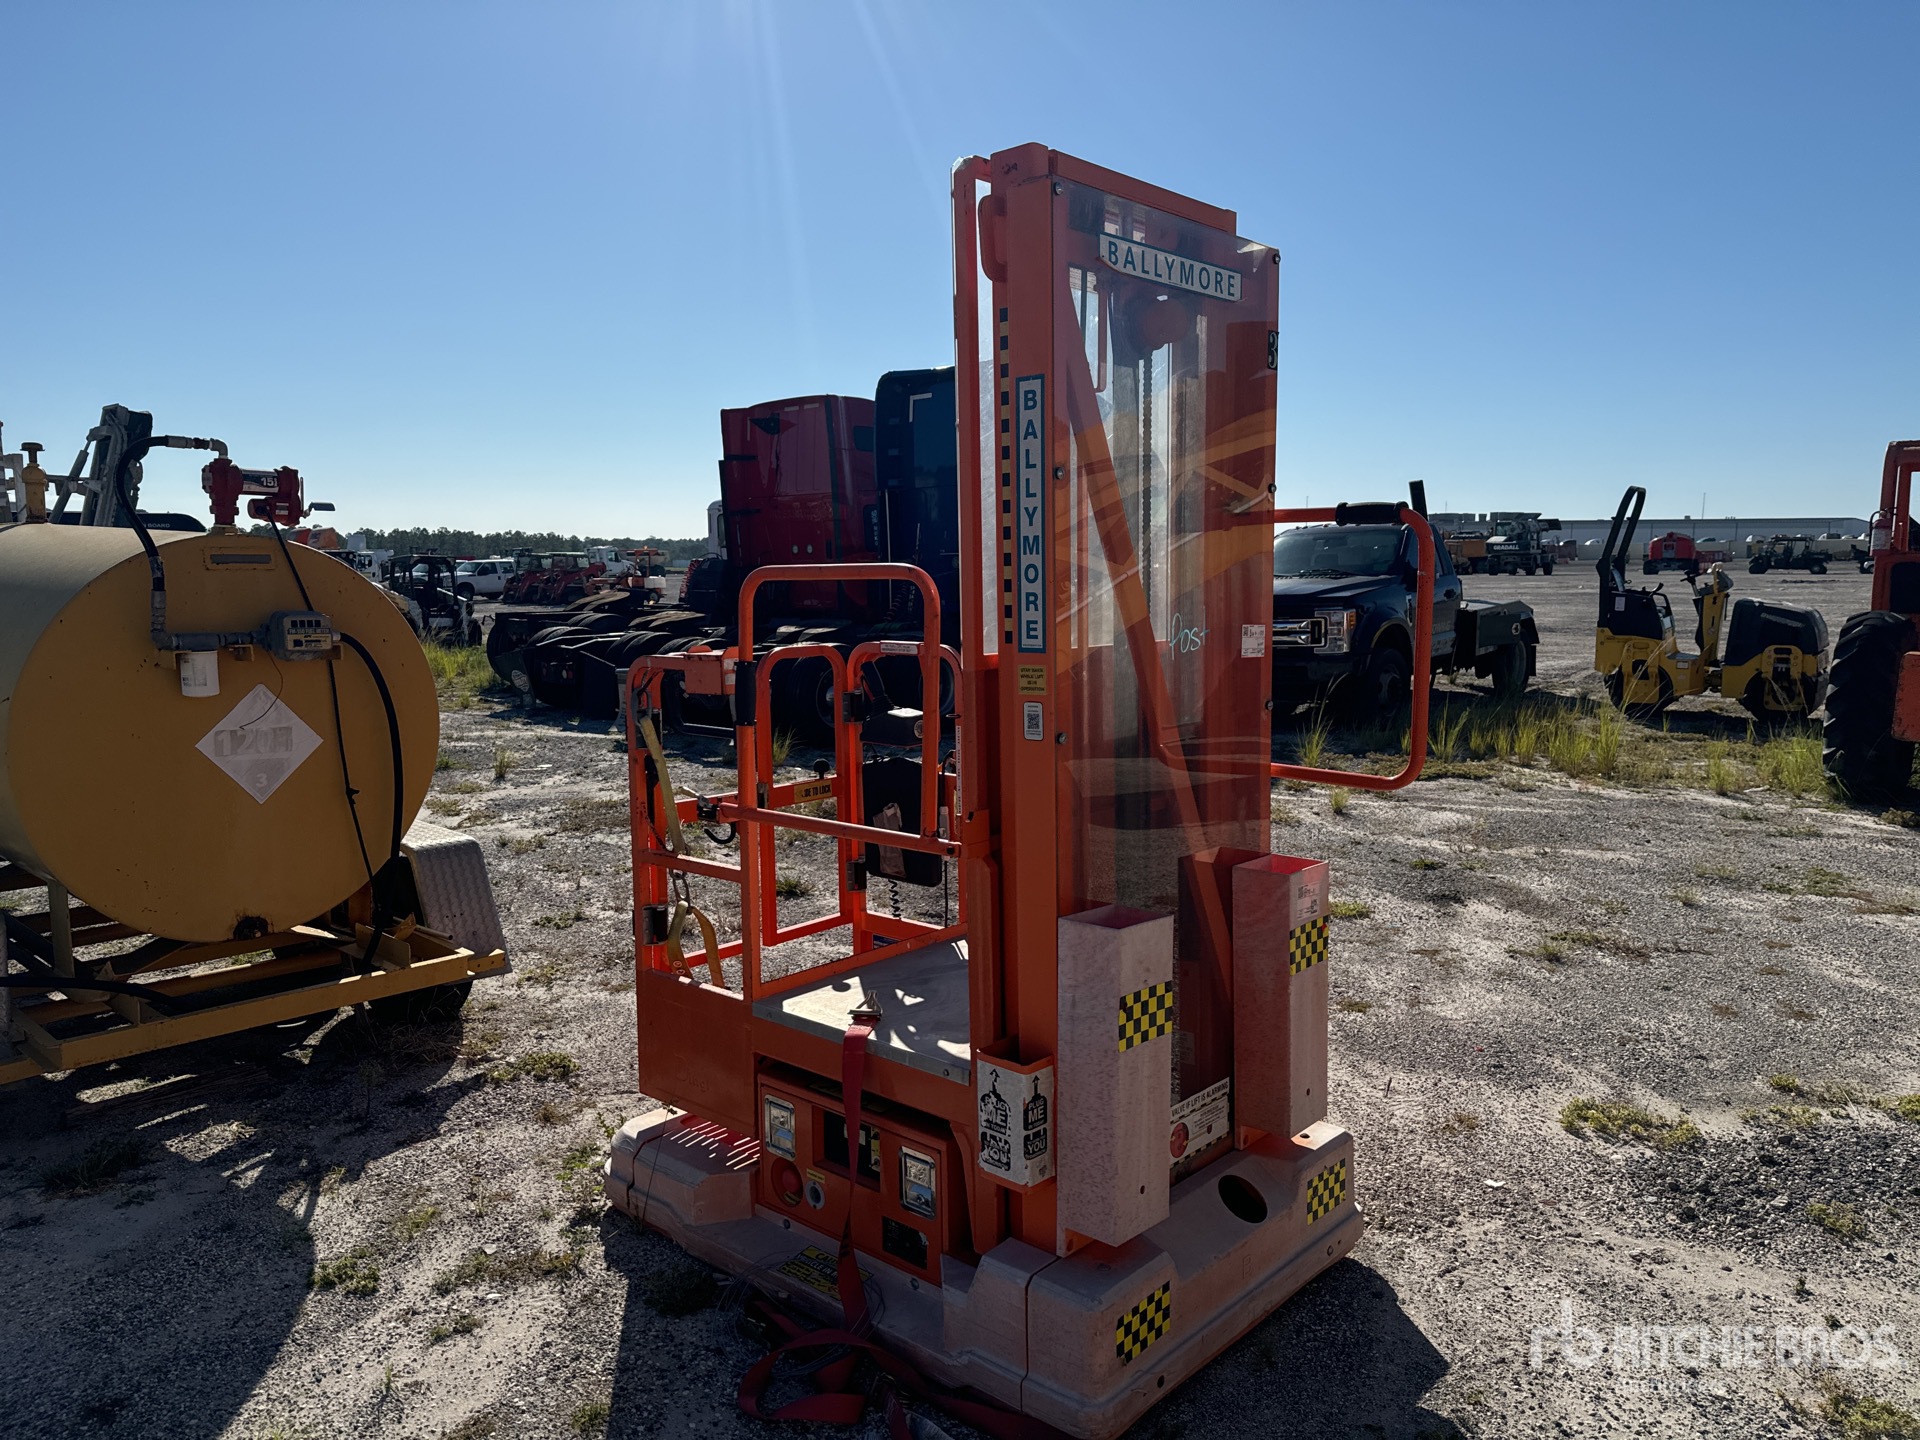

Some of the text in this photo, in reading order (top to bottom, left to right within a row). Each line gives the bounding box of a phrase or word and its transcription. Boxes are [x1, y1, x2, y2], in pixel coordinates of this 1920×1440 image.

[1108, 240, 1236, 297] BALLYMORE
[1022, 389, 1040, 640] BALLYMORE
[255, 773, 268, 788] 3
[1191, 1095, 1201, 1107] LIFT
[1206, 1080, 1229, 1098] ALARMING
[1028, 1098, 1044, 1111] PLUG
[1028, 1107, 1044, 1123] ME
[1028, 1138, 1045, 1155] YOU
